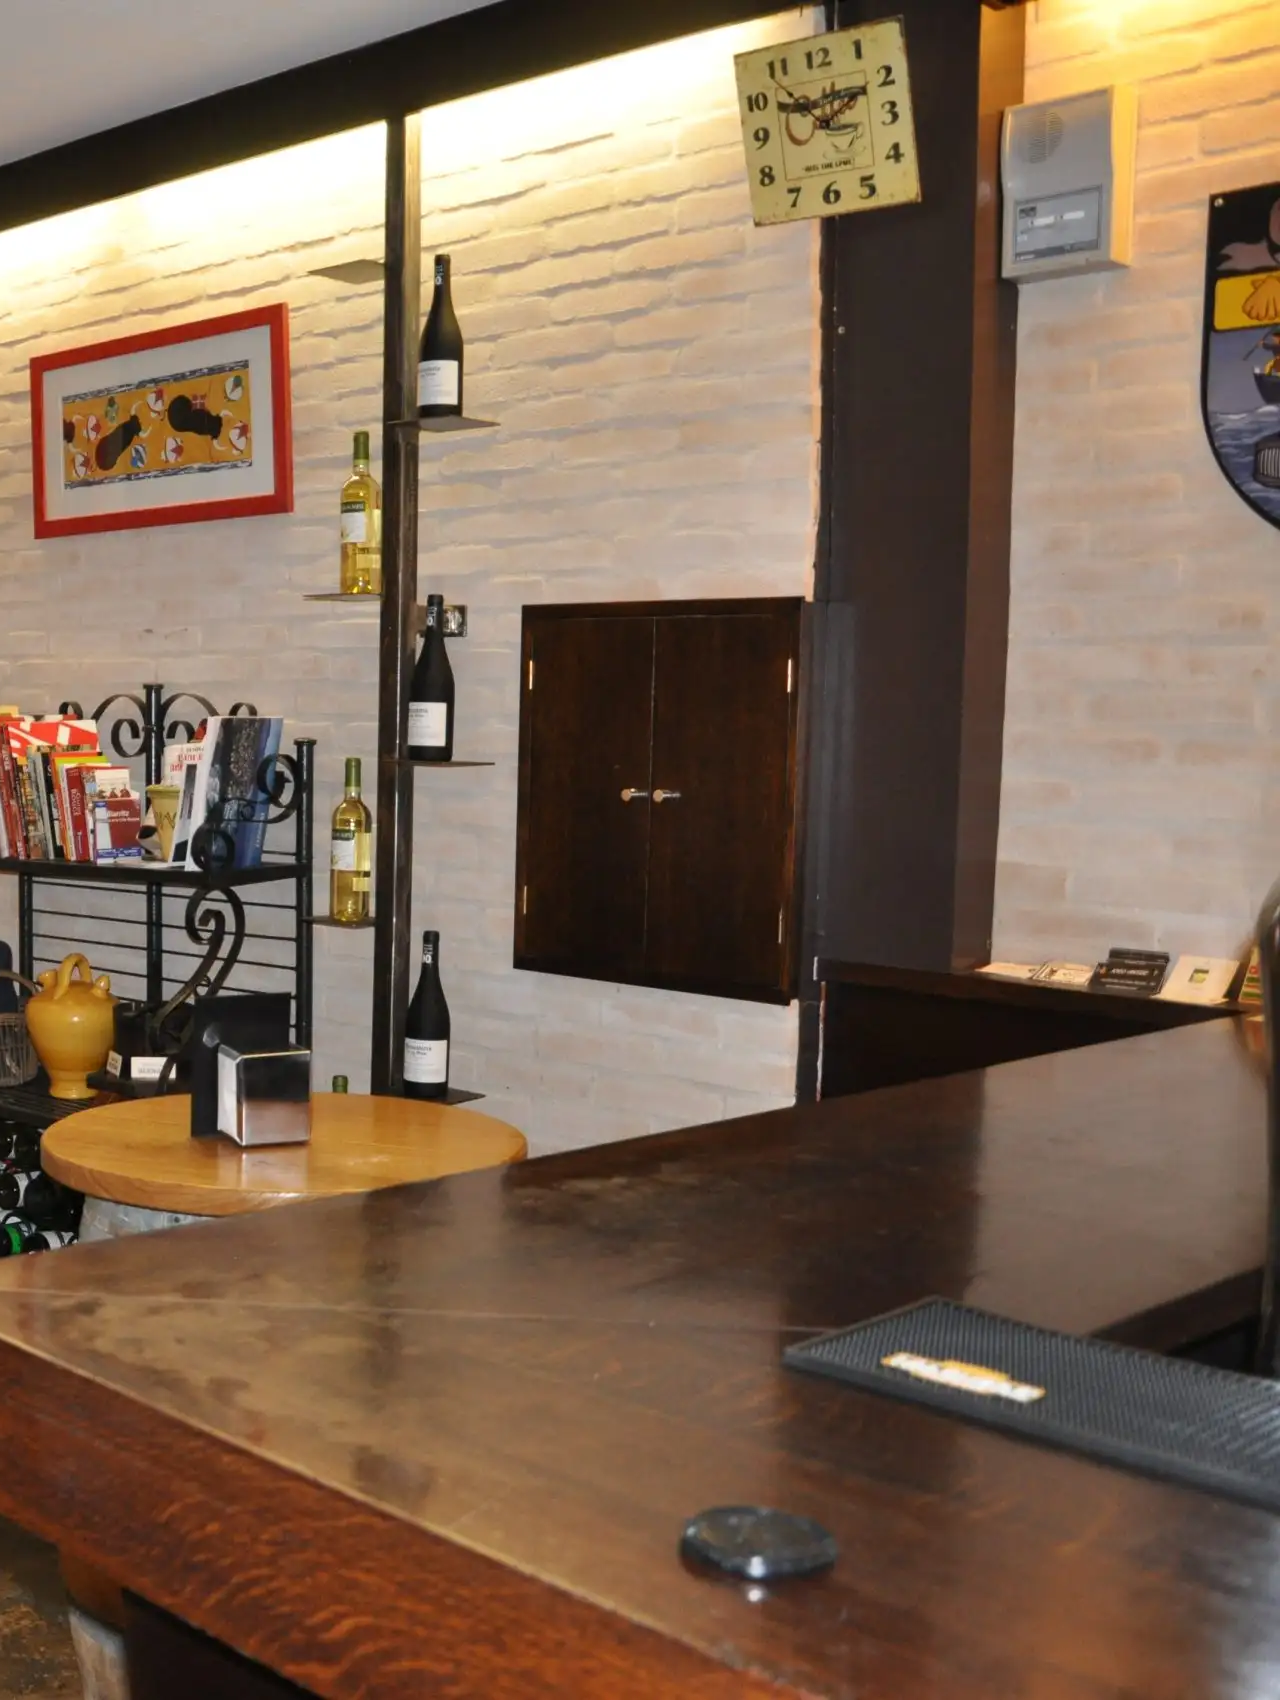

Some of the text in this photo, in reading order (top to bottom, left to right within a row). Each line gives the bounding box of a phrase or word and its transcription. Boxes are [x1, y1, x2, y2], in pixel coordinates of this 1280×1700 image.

[805, 47, 832, 70] 12
[852, 38, 863, 60] 1
[767, 57, 789, 79] 11
[876, 65, 896, 87] 2
[746, 92, 768, 113] 10
[881, 101, 900, 125] 3
[753, 127, 770, 150] 9
[885, 142, 905, 164] 4
[759, 165, 776, 187] 8
[859, 174, 877, 200] 5
[787, 186, 801, 208] 7
[822, 181, 841, 205] 6
